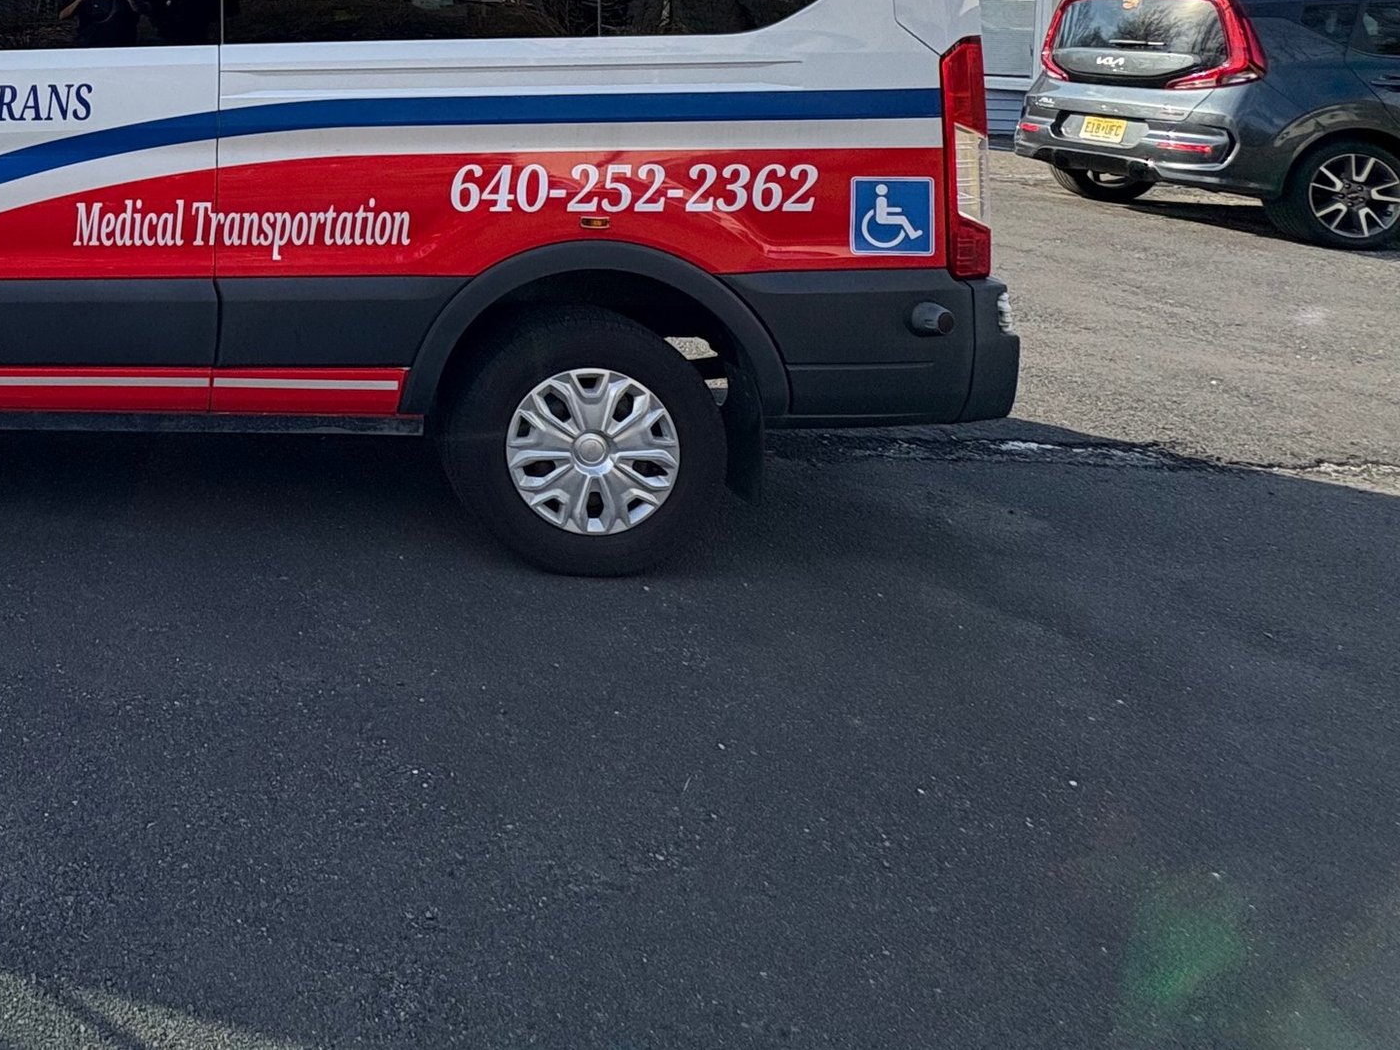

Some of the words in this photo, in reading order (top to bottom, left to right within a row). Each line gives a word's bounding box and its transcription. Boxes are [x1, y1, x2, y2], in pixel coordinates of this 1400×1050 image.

[450, 164, 817, 213] 640-252-2362
[73, 199, 185, 247] Medical
[192, 199, 411, 260] Transportation
